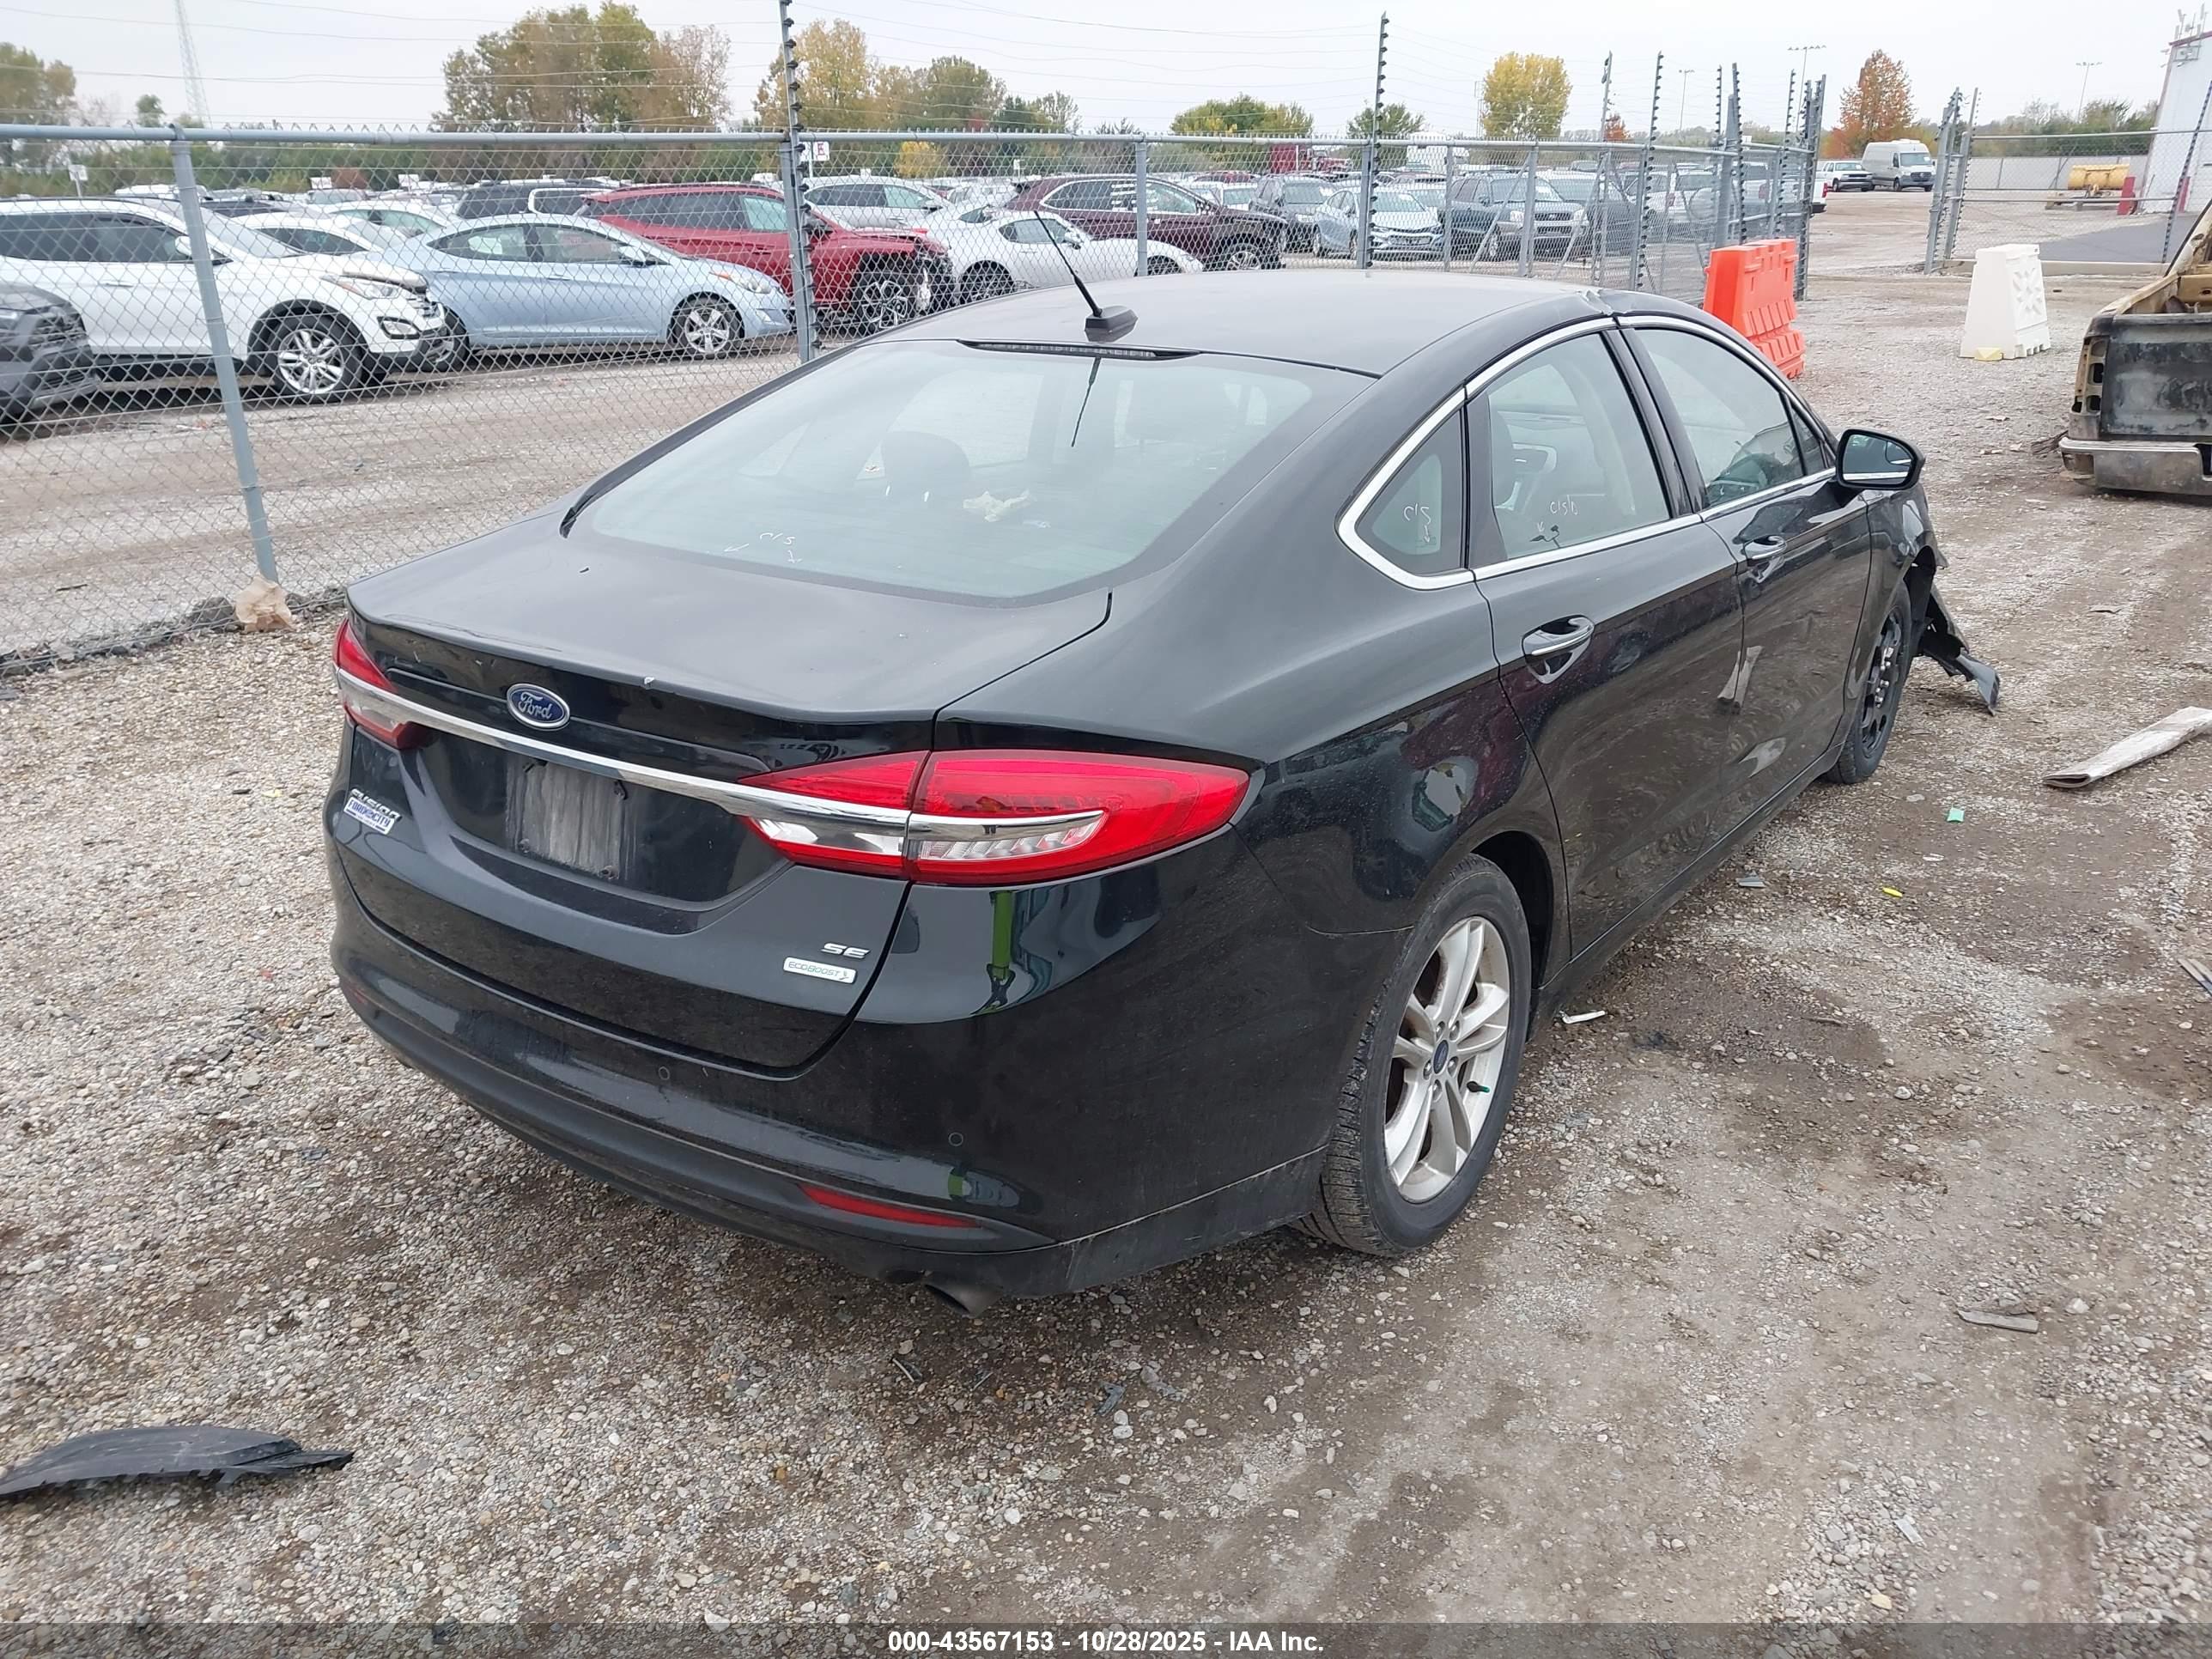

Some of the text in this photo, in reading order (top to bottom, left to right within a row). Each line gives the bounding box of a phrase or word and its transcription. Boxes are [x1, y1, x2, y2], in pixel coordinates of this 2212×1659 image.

[518, 691, 553, 720] Ford
[372, 813, 392, 827] CITY
[820, 942, 871, 959] SE
